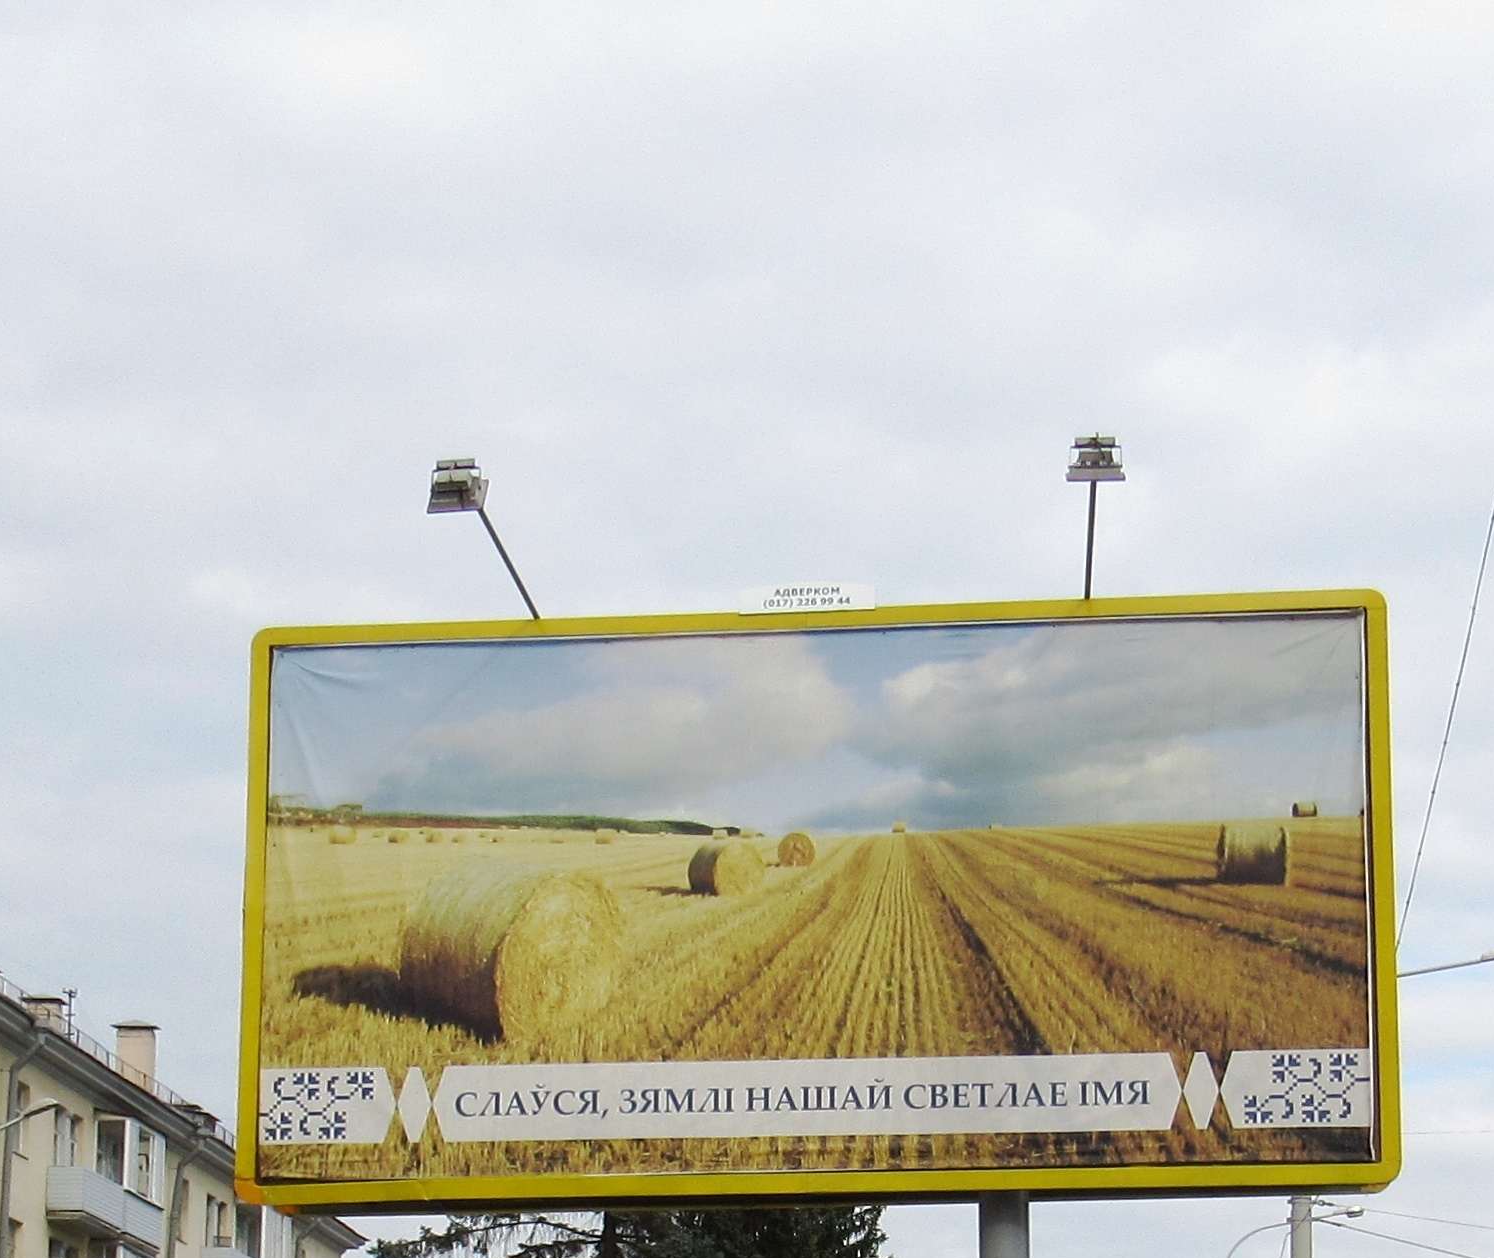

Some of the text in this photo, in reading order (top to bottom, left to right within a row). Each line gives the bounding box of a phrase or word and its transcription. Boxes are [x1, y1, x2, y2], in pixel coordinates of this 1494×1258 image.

[774, 587, 840, 598] АДВЕРКОМ
[763, 599, 793, 609] (017)
[797, 598, 817, 606] 226
[820, 597, 834, 605] 99
[455, 1078, 1151, 1119] СЛАЎСЯ, ЗЯМЛІ НАШАЙ СВЕТЛАЕ ІМЯ
